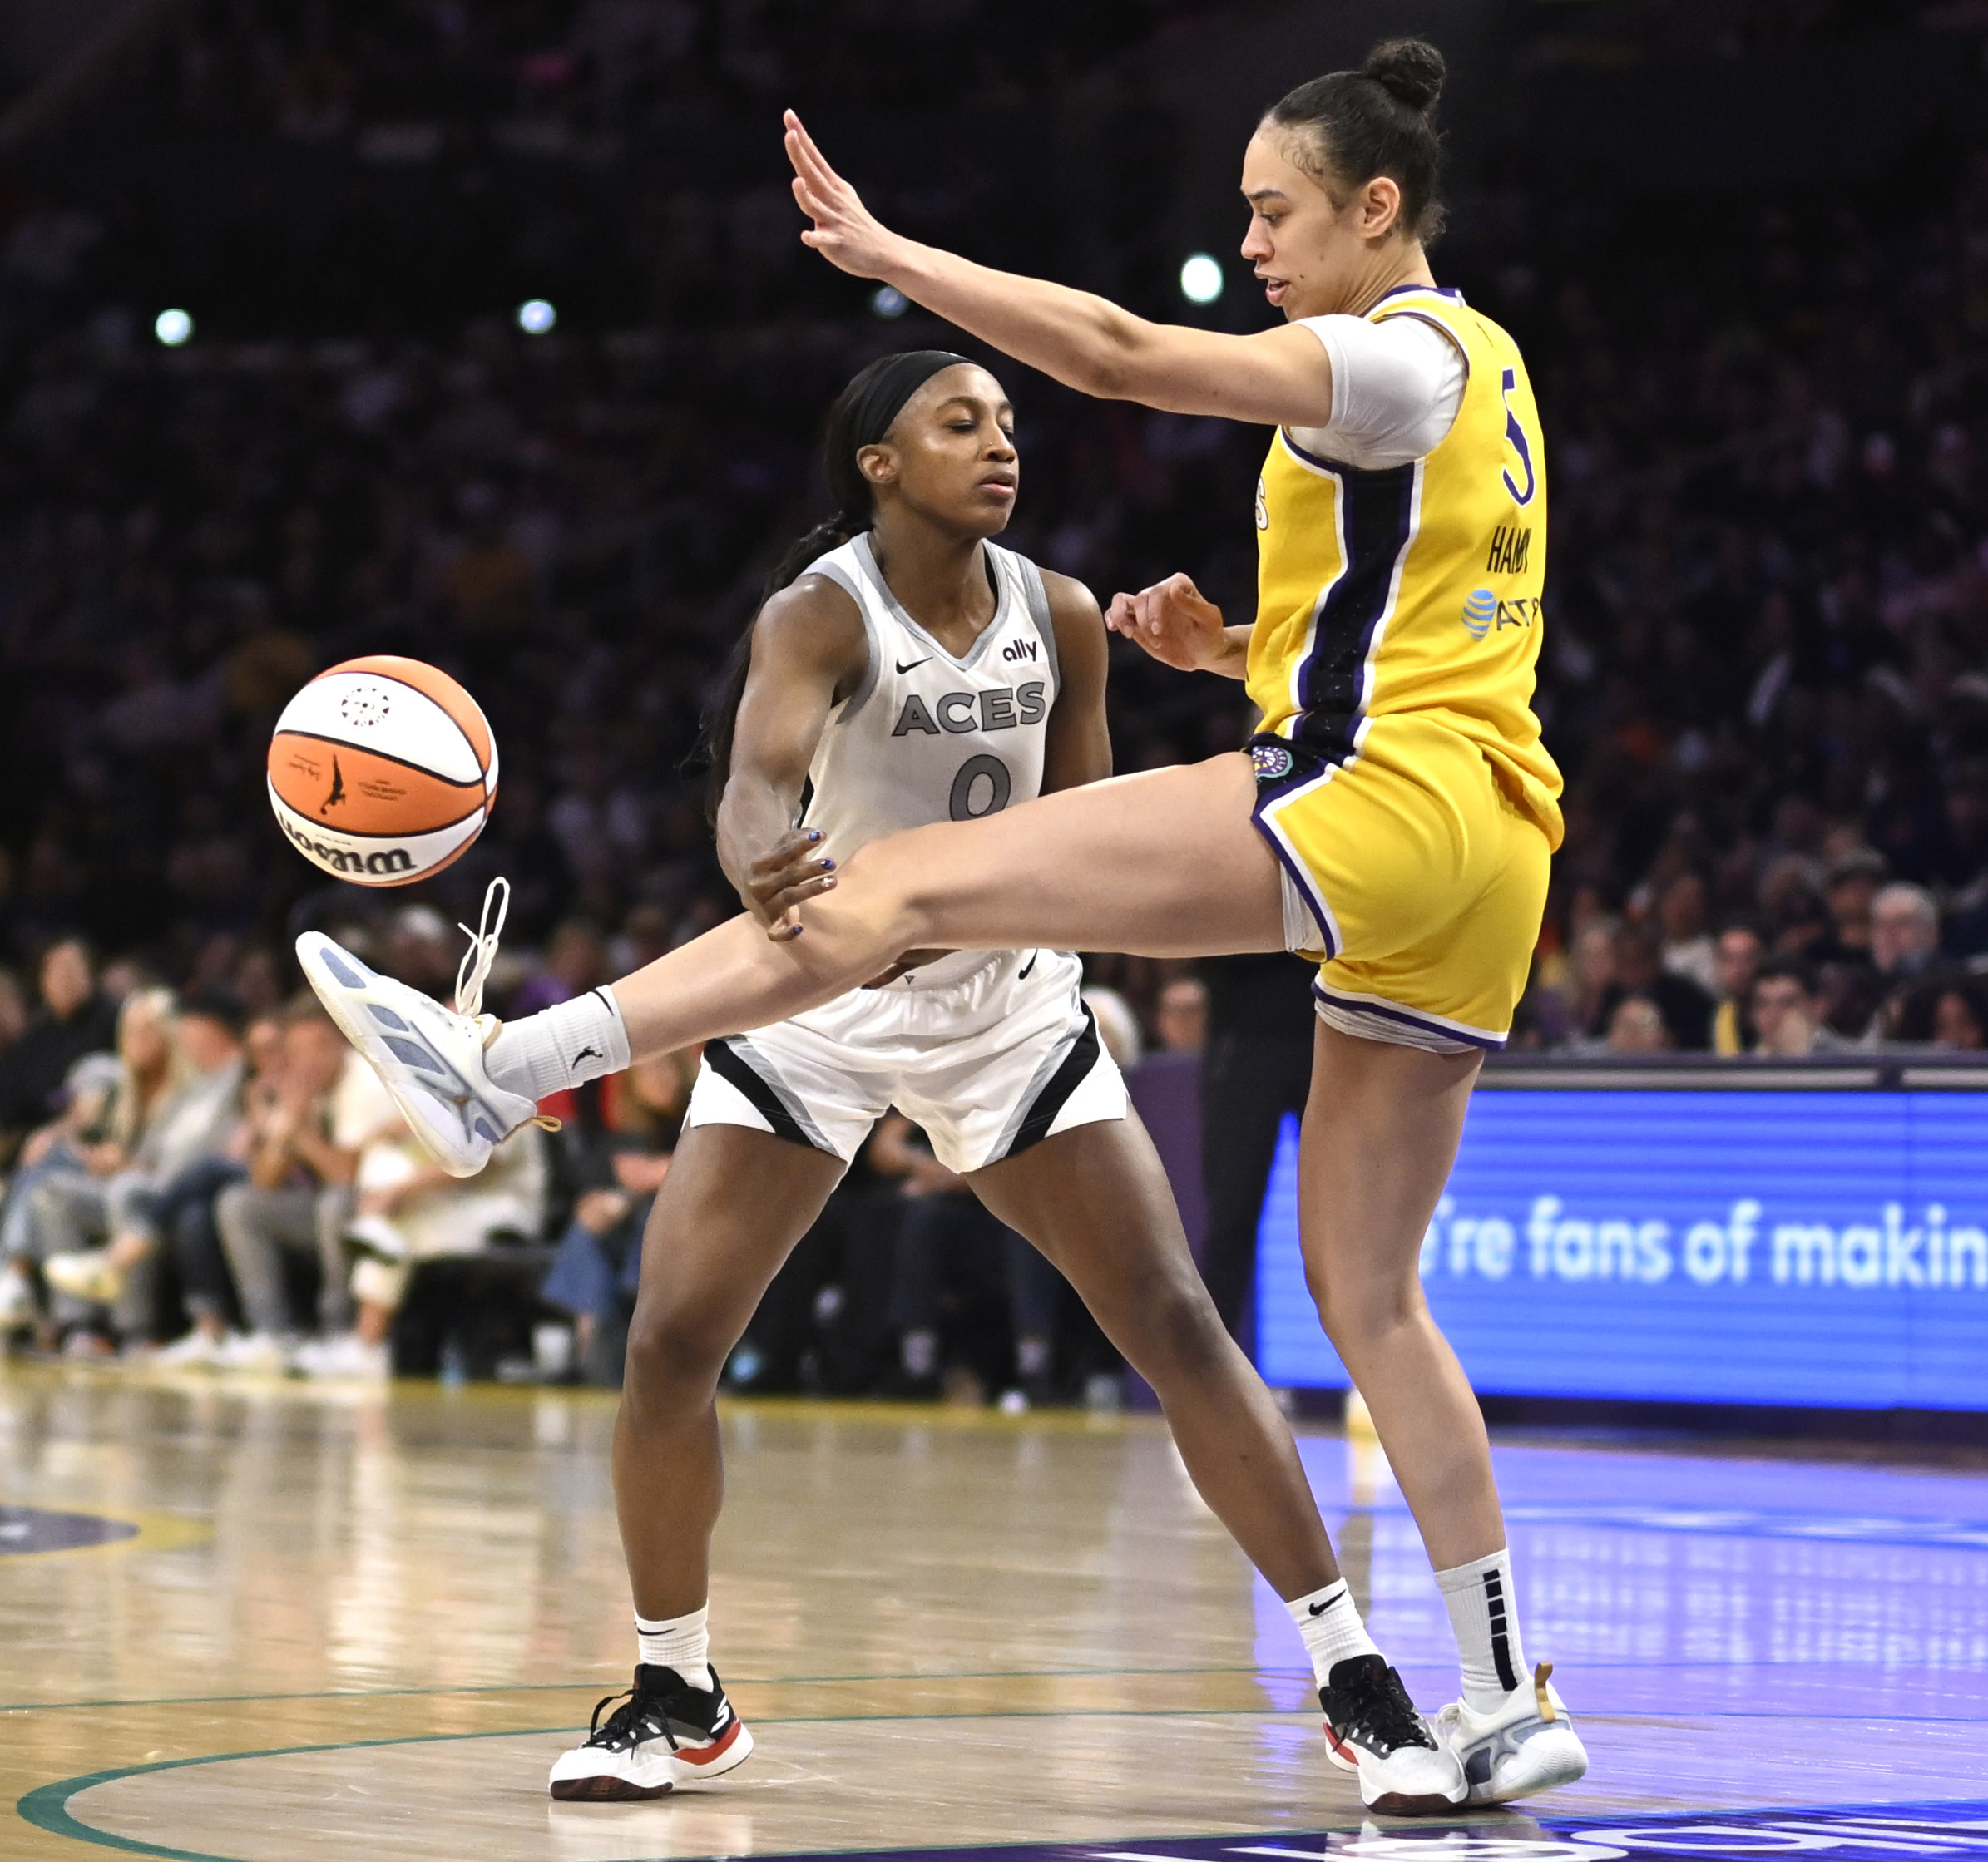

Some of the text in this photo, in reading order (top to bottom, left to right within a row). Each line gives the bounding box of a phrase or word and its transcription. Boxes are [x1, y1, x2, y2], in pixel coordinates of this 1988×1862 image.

[1501, 368, 1536, 506] 5
[1002, 638, 1037, 662] ally
[891, 681, 1046, 737] ACES
[949, 753, 1011, 822] 0
[278, 808, 417, 875] Wilson
[1528, 1195, 1673, 1282] fans
[1683, 1198, 1762, 1284] of
[1772, 1200, 1988, 1289] makin
